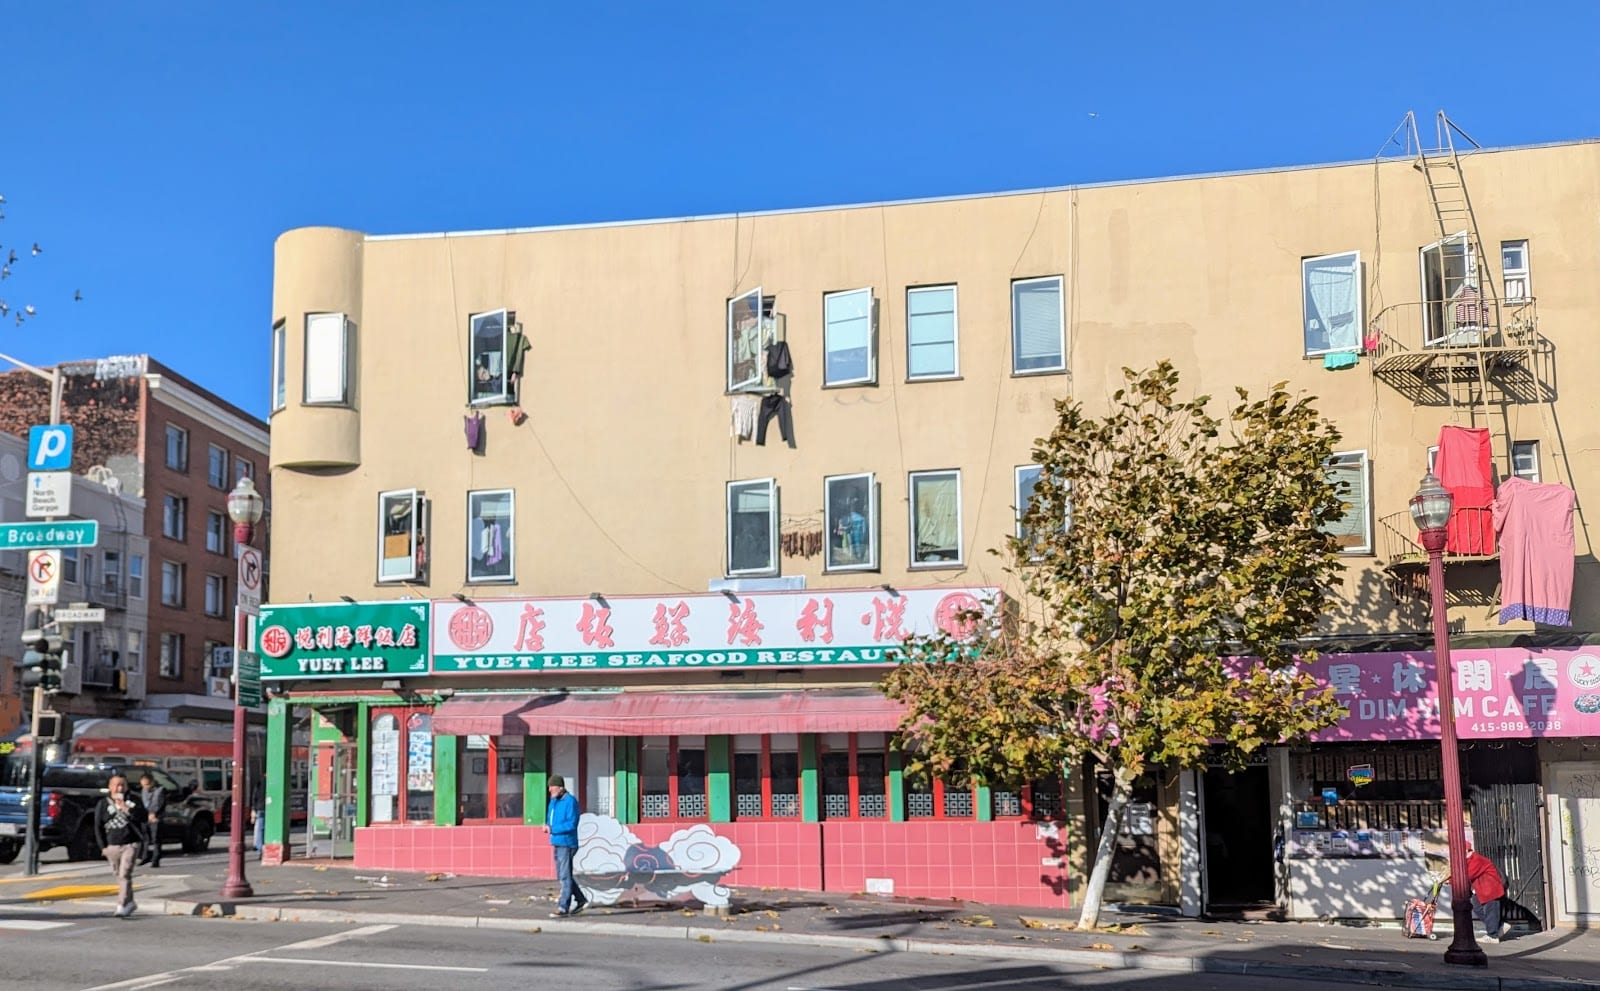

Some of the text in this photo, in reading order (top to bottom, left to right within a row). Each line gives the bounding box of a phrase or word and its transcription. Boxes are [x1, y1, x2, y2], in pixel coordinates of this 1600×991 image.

[8, 529, 85, 544] Broadway
[297, 657, 384, 671] YUET LEE
[453, 656, 535, 669] YUET
[543, 655, 597, 667] LEE
[607, 652, 748, 666] SEAFOOD
[1359, 698, 1406, 720] DIM
[1482, 694, 1558, 718] CAFE
[1471, 720, 1562, 732] 415-989-2038
